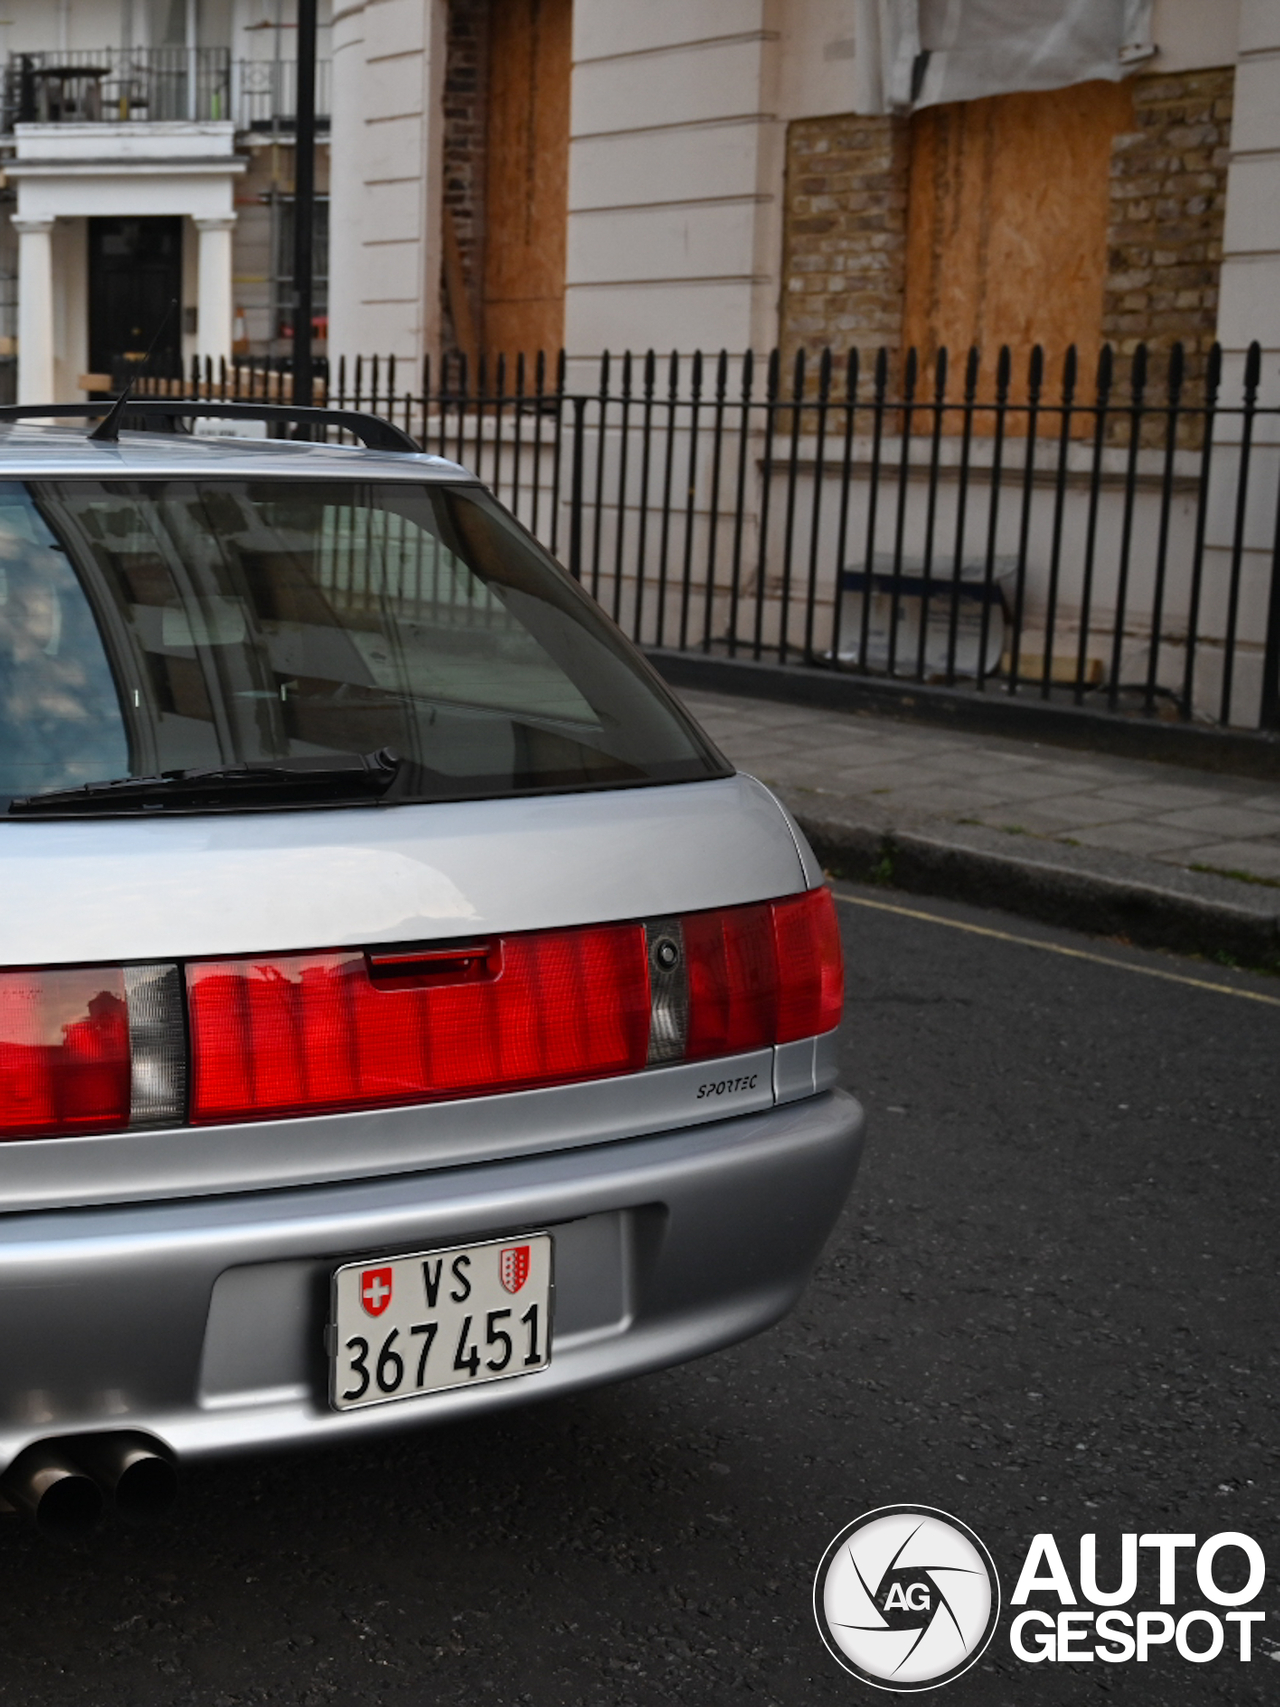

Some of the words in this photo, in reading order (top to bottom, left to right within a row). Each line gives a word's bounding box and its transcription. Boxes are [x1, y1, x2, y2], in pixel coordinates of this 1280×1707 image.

[697, 1074, 758, 1099] SPORTEC
[422, 1255, 472, 1308] VS
[342, 1322, 439, 1400] 367
[453, 1303, 542, 1377] 451
